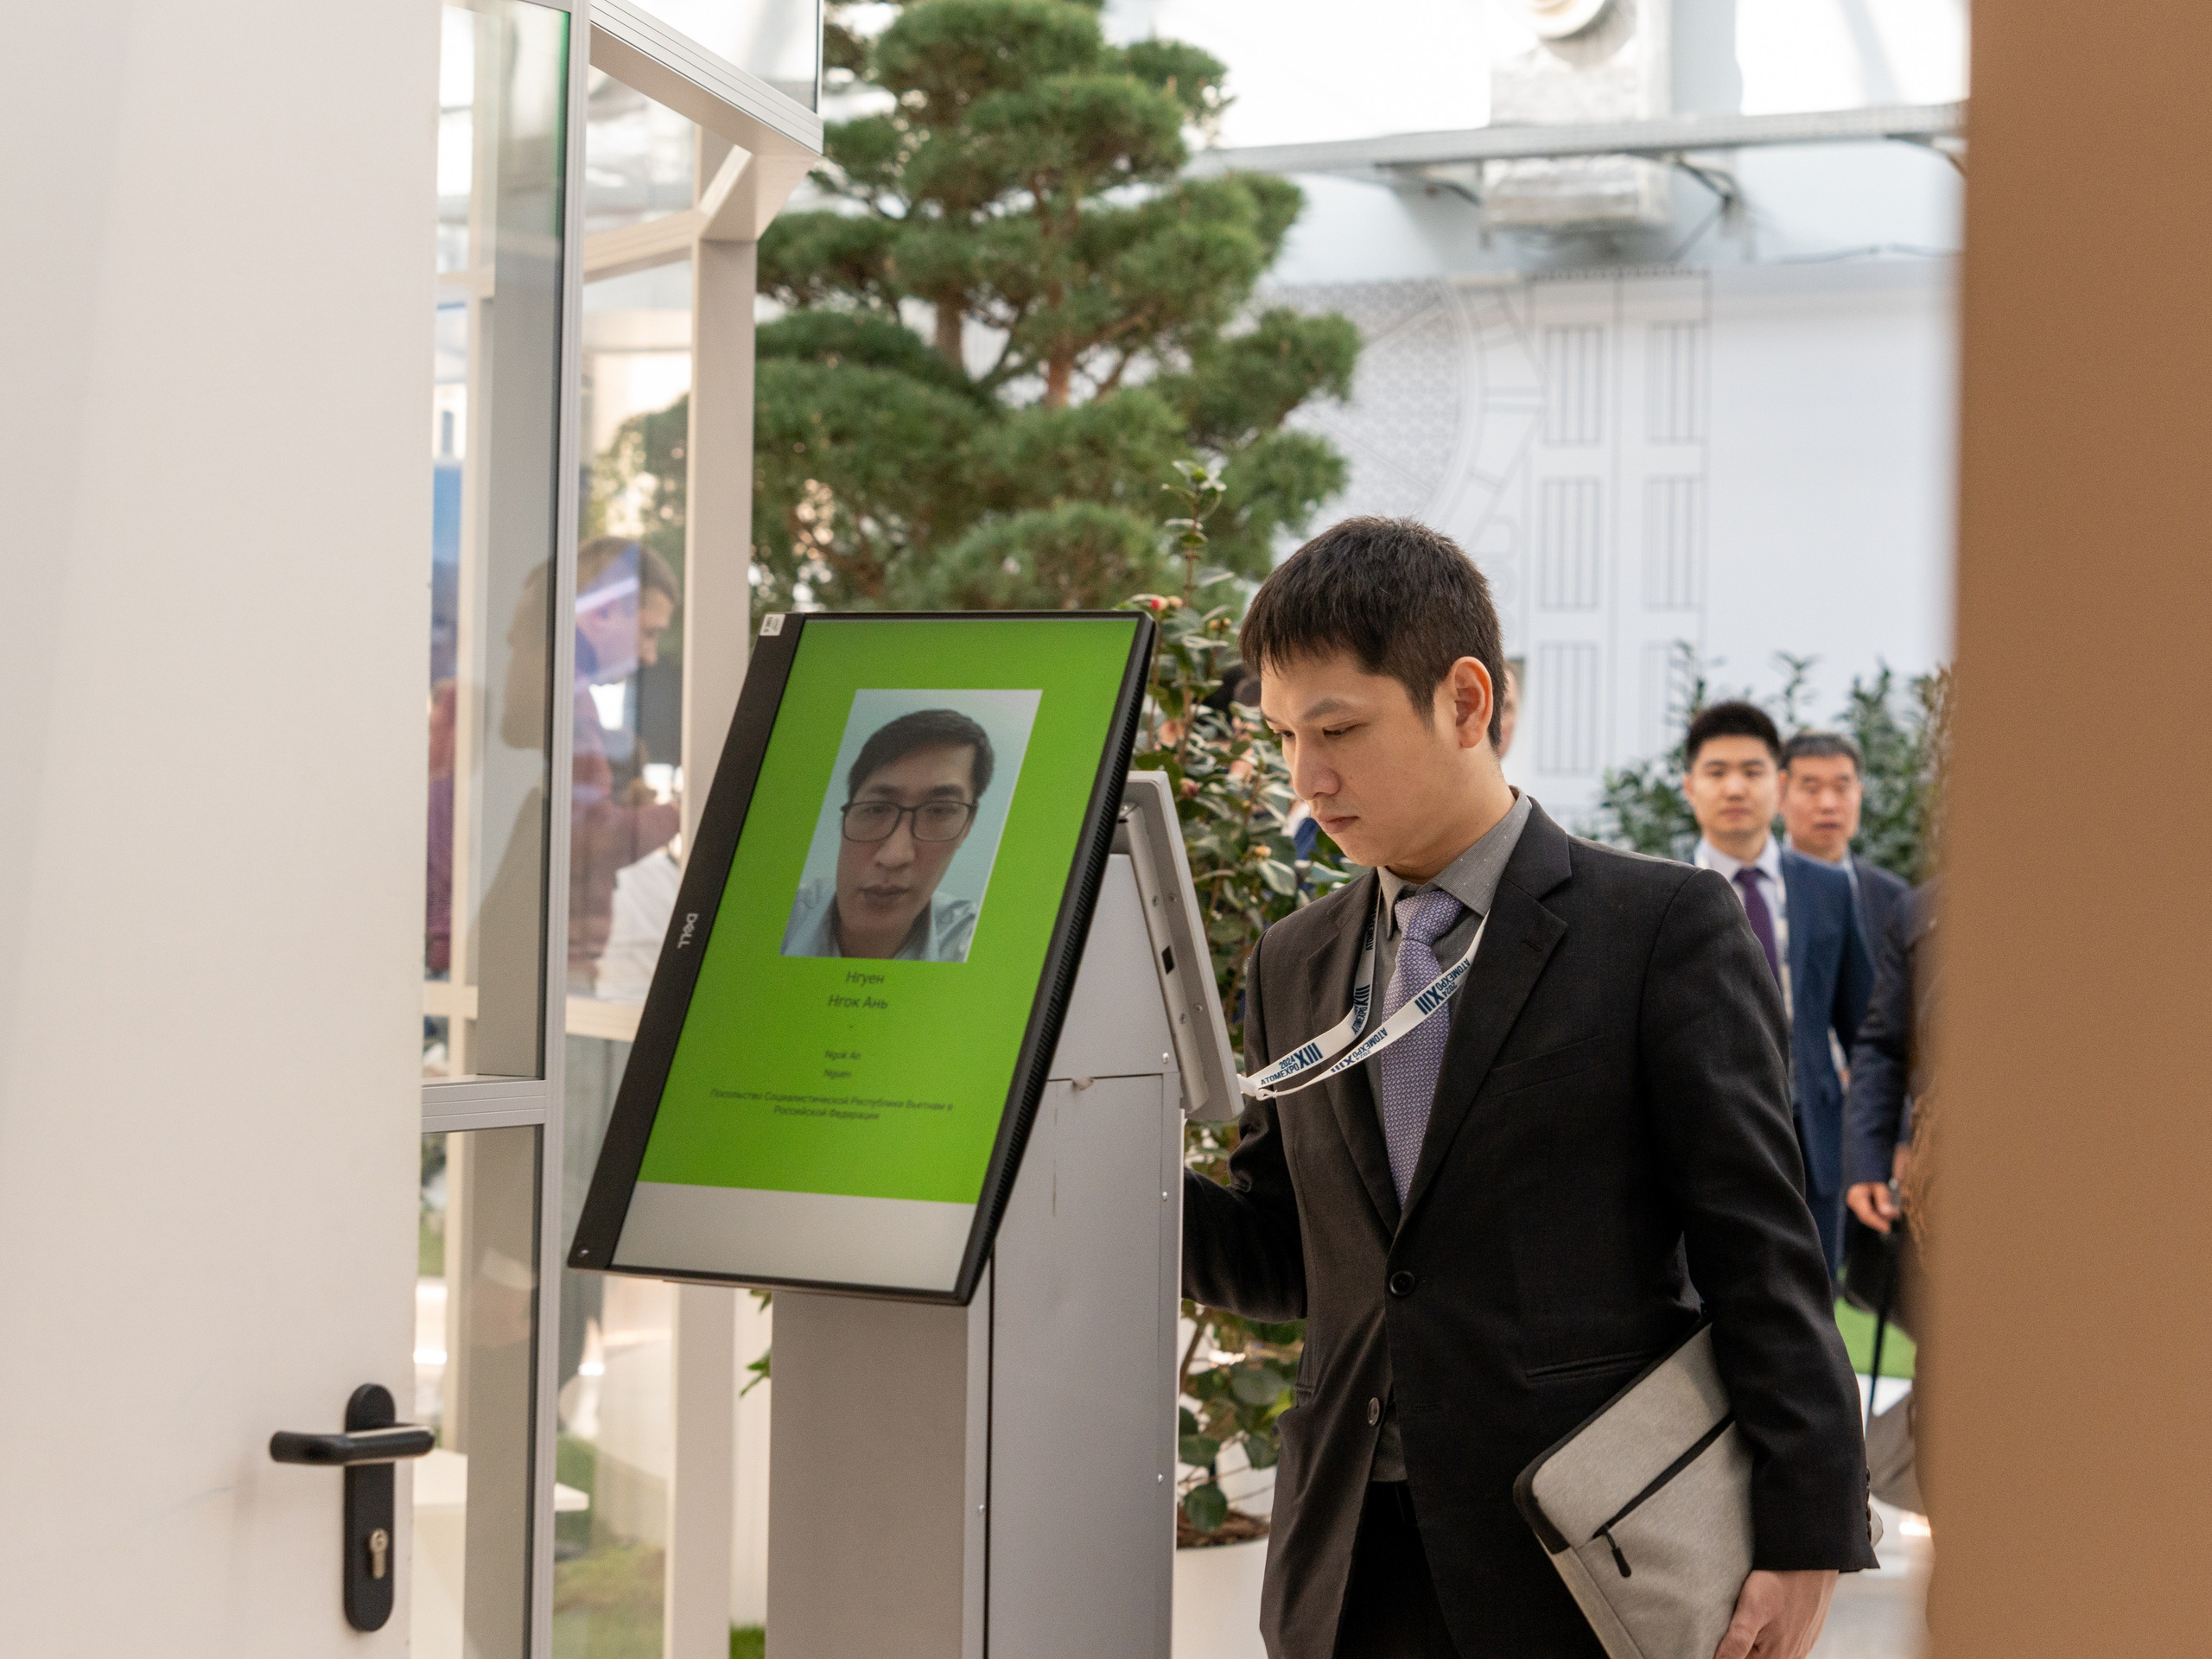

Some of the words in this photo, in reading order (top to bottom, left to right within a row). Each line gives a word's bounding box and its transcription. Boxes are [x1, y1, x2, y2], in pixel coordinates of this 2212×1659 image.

[677, 912, 699, 949] DELL
[845, 970, 885, 987] Нгуен
[1436, 958, 1471, 991] ATOMEXPO
[1414, 985, 1446, 1015] XIII
[1442, 982, 1458, 997] 2024
[828, 995, 860, 1008] Нгок
[862, 996, 888, 1009] Ань
[1352, 1027, 1389, 1058] ATOMEXPO
[1279, 1056, 1295, 1070] 2024
[1294, 1042, 1324, 1069] XIII
[1261, 1063, 1300, 1085] ATOMEXPO
